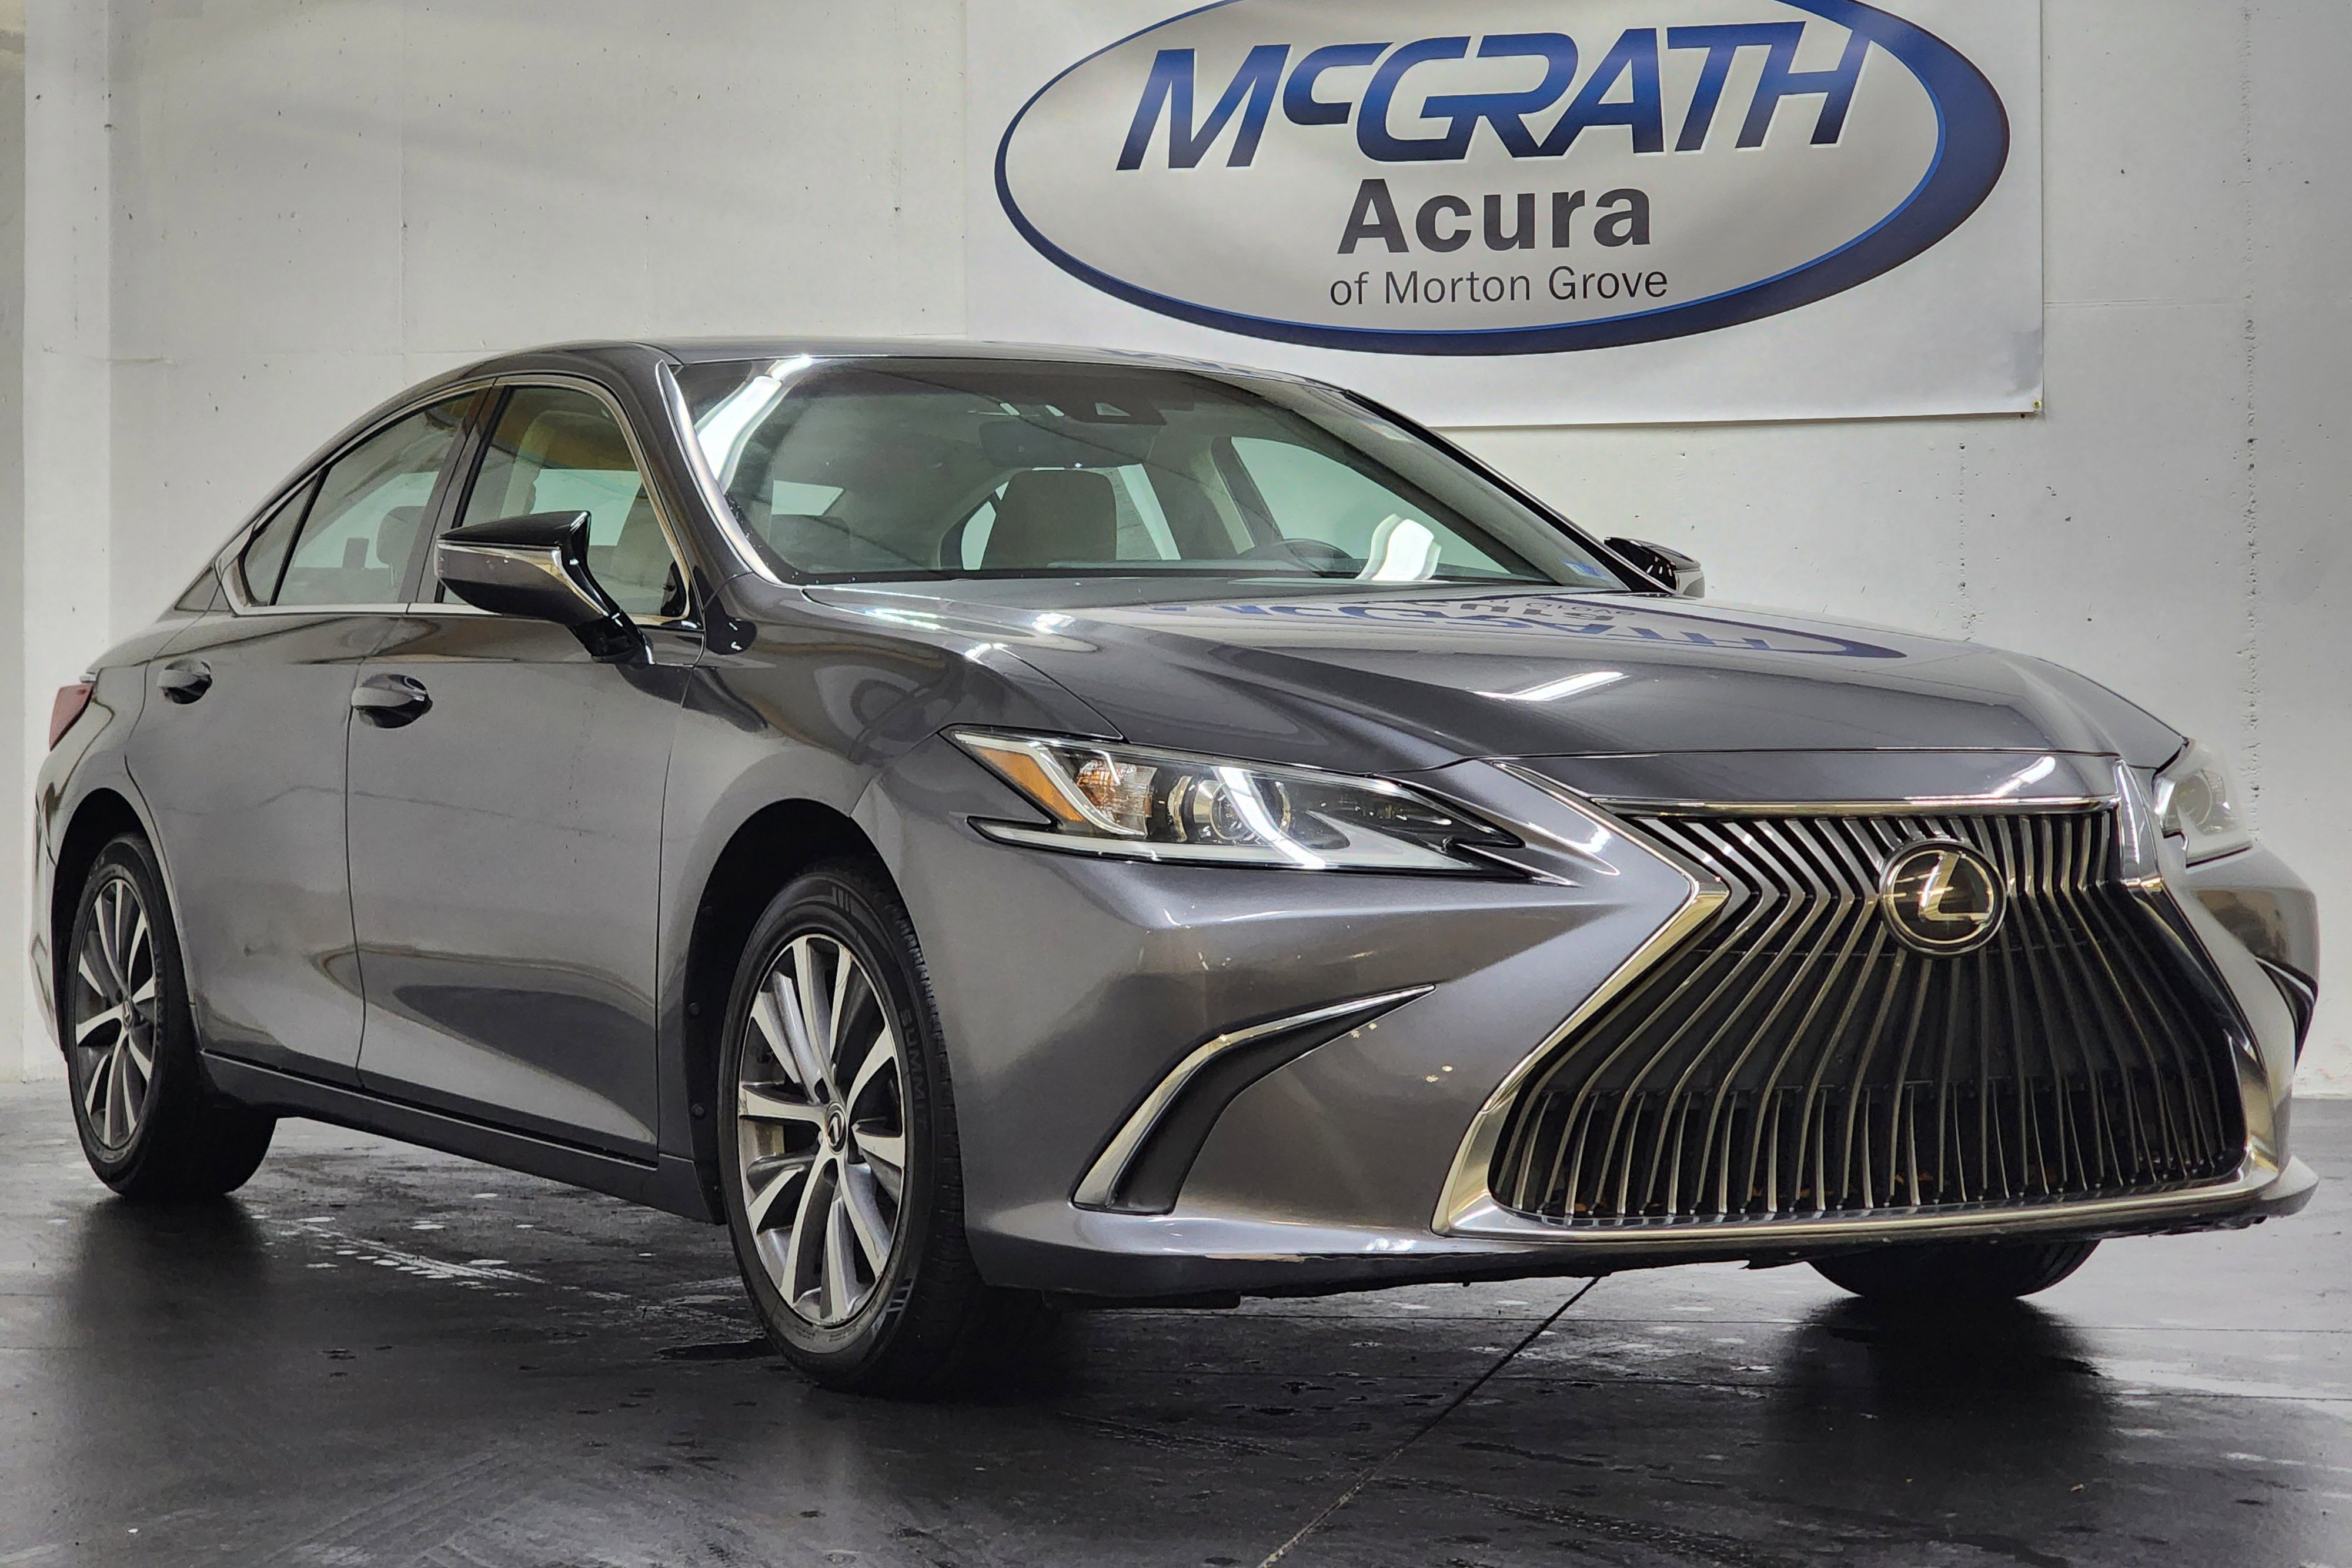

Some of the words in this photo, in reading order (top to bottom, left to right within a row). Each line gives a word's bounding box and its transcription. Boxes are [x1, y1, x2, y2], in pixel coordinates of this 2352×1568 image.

[1337, 178, 1651, 255] Acura
[1329, 271, 1369, 306] of
[1385, 270, 1531, 305] Morton
[1548, 265, 1668, 300] Grove
